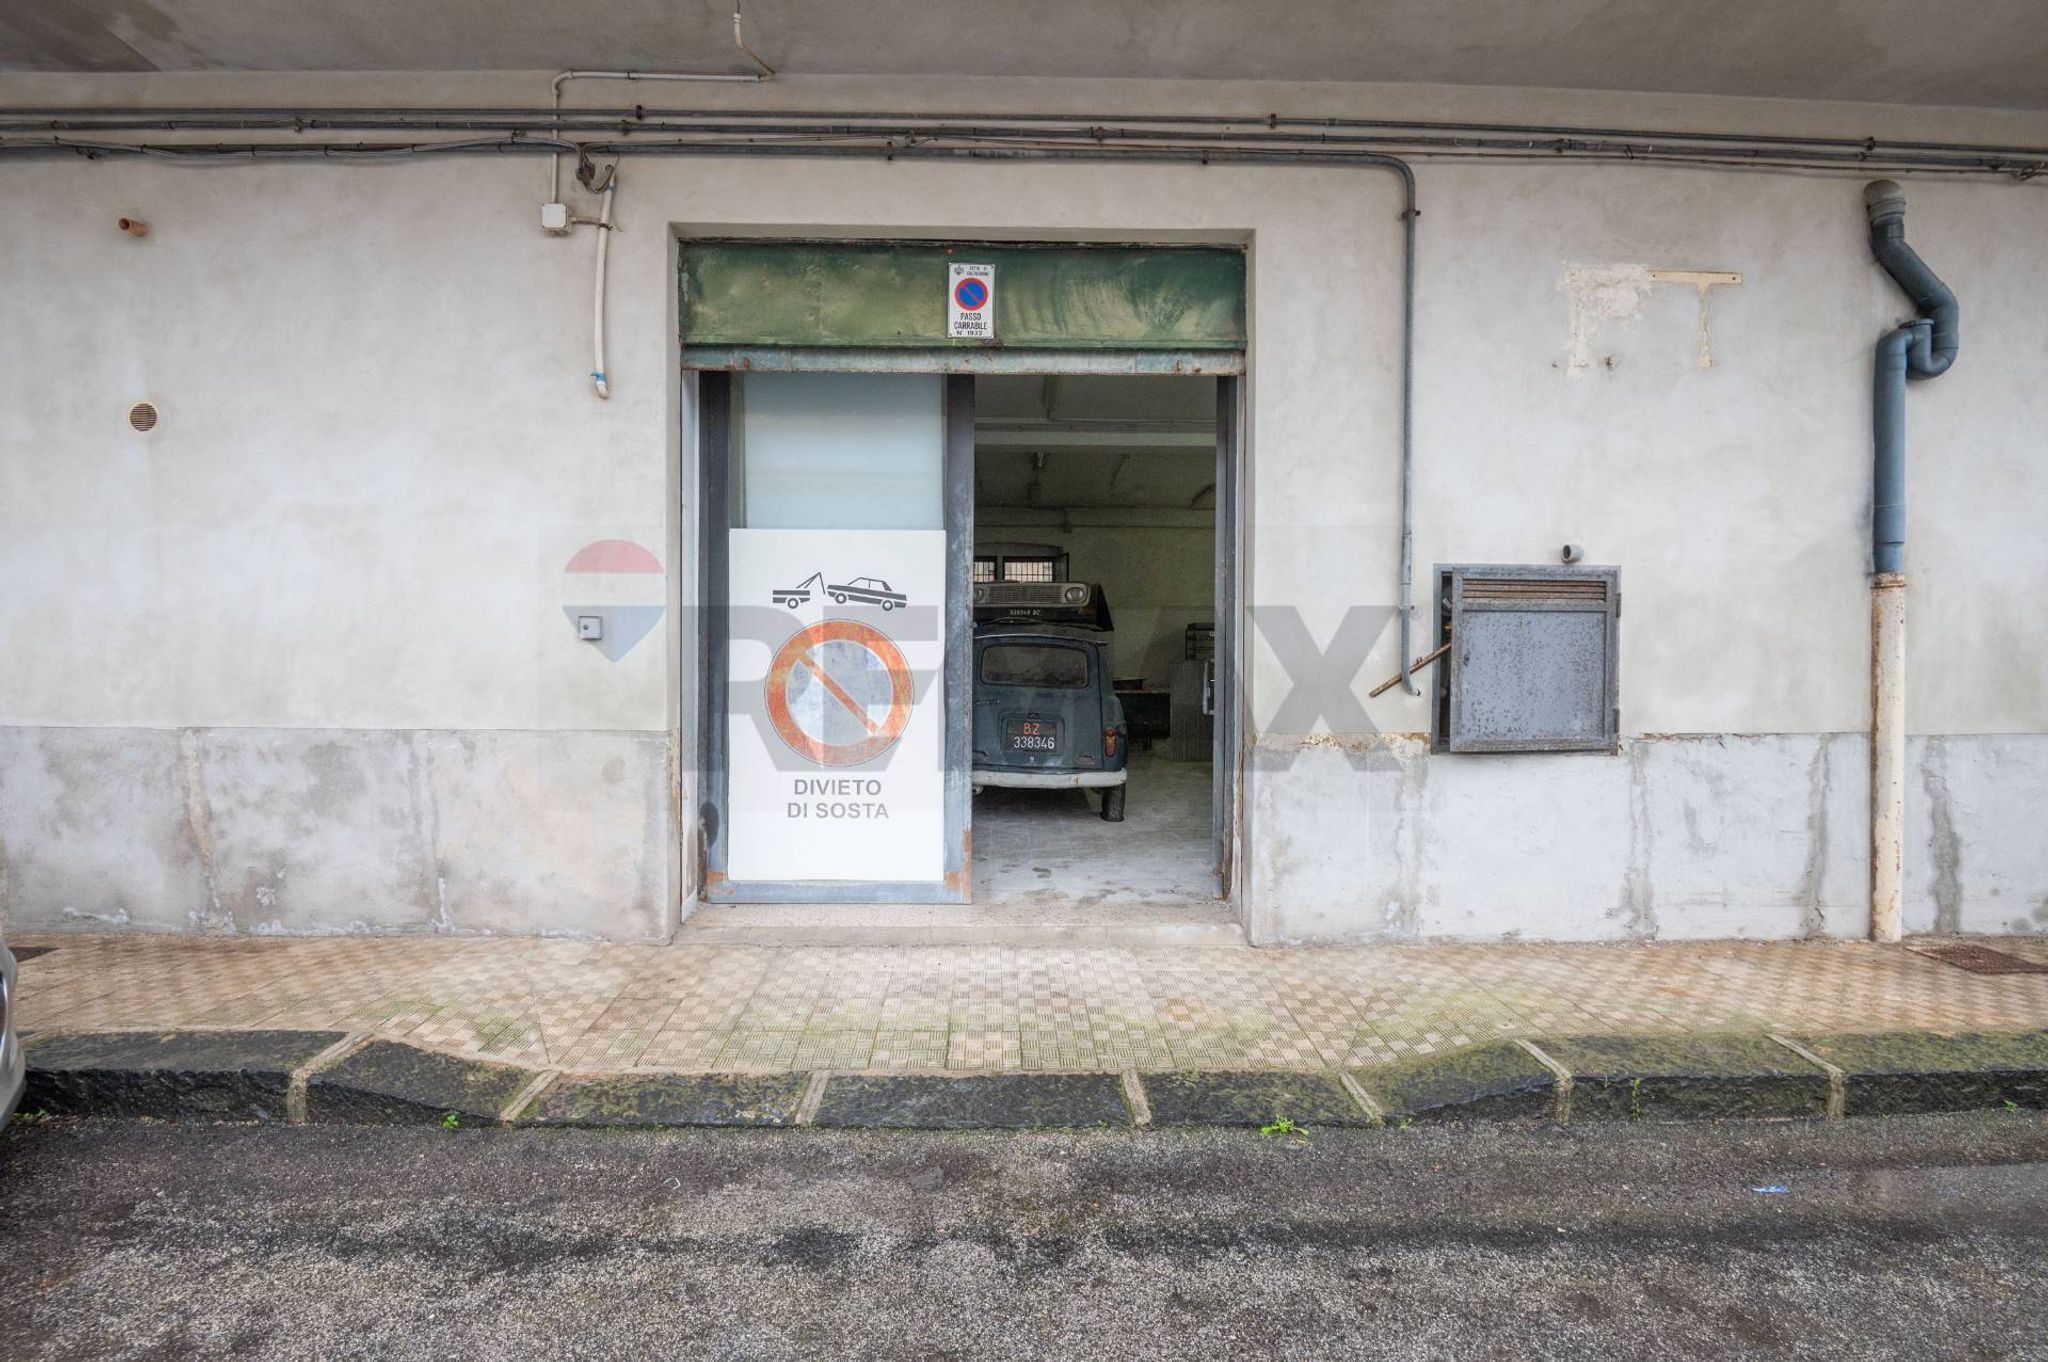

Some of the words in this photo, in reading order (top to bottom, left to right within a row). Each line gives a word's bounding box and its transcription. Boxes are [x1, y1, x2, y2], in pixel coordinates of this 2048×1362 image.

[960, 312, 982, 321] PASSO
[954, 321, 988, 330] CARRABILE
[1023, 722, 1041, 735] BZ
[1014, 736, 1055, 749] 338346
[793, 779, 882, 796] DIVIETO
[787, 802, 808, 818] DI
[815, 802, 890, 819] SOSTA
